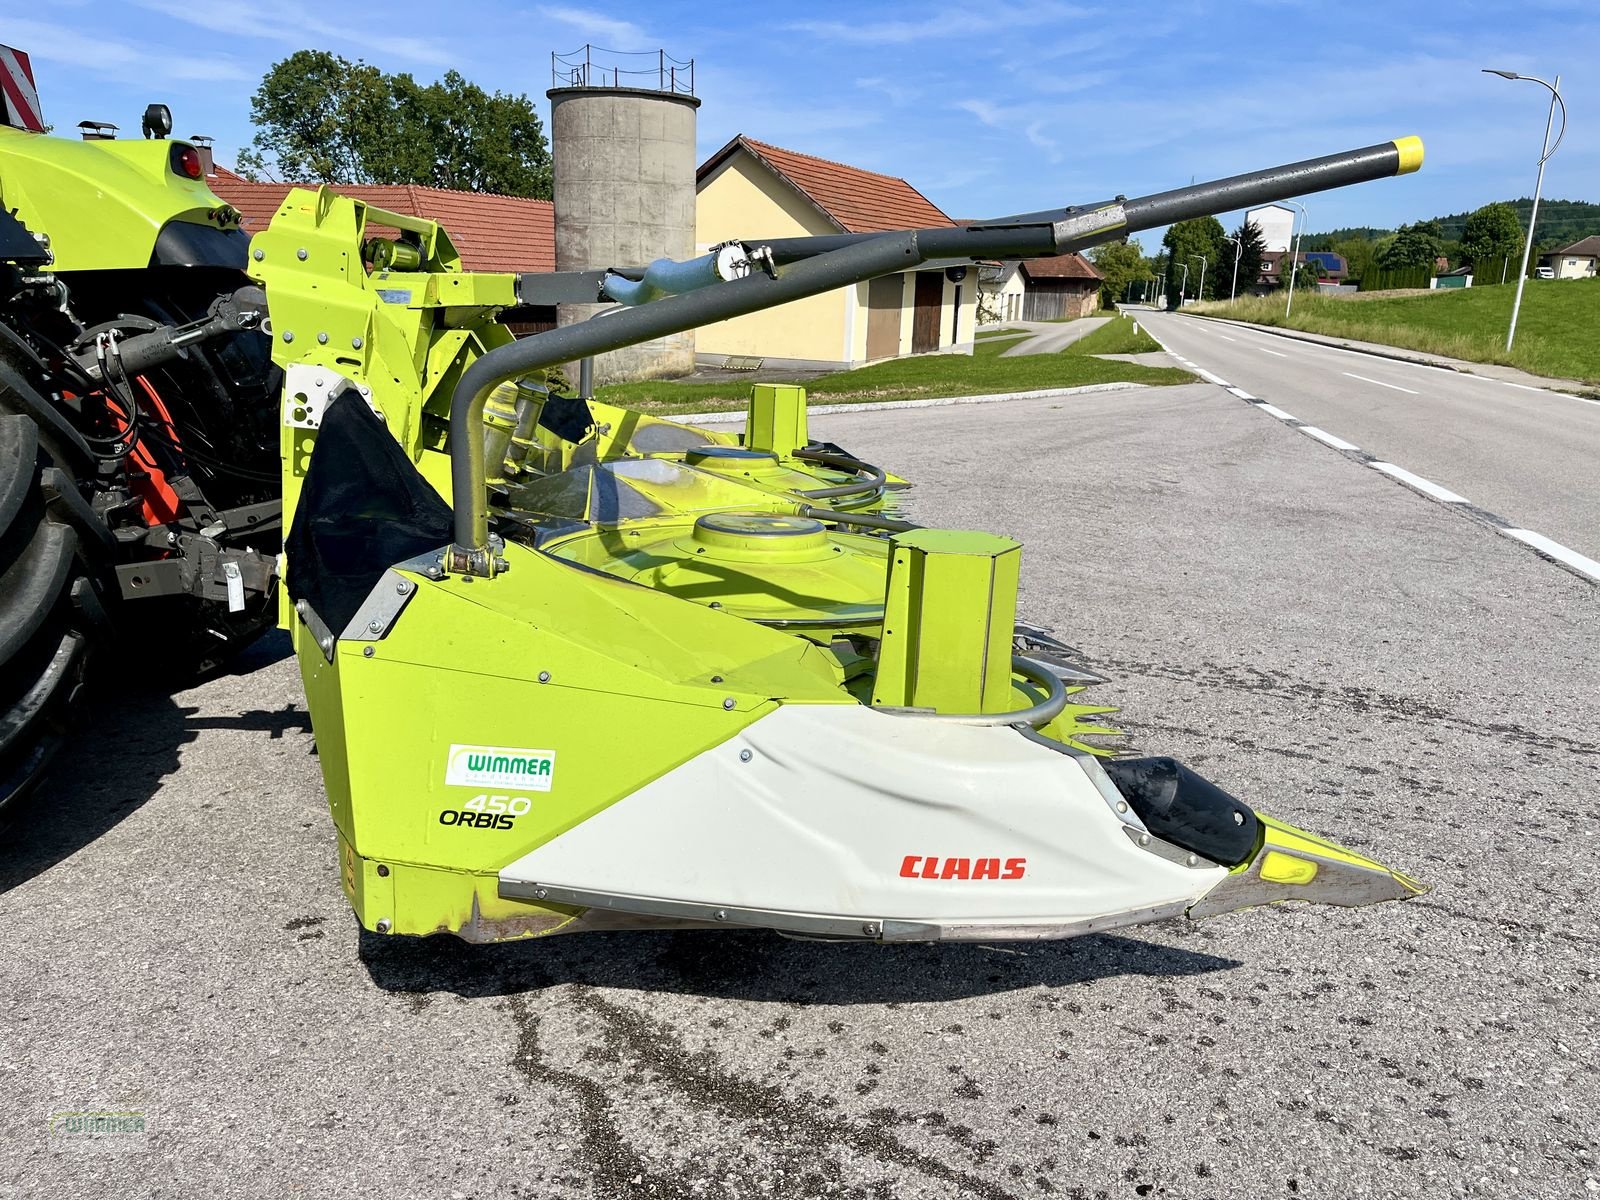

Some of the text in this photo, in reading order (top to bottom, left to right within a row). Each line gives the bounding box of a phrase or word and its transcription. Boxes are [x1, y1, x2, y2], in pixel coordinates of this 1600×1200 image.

[468, 754, 551, 776] WIMMER
[464, 794, 532, 816] 450
[439, 810, 516, 830] ORBIS
[899, 855, 1026, 880] CLAAS
